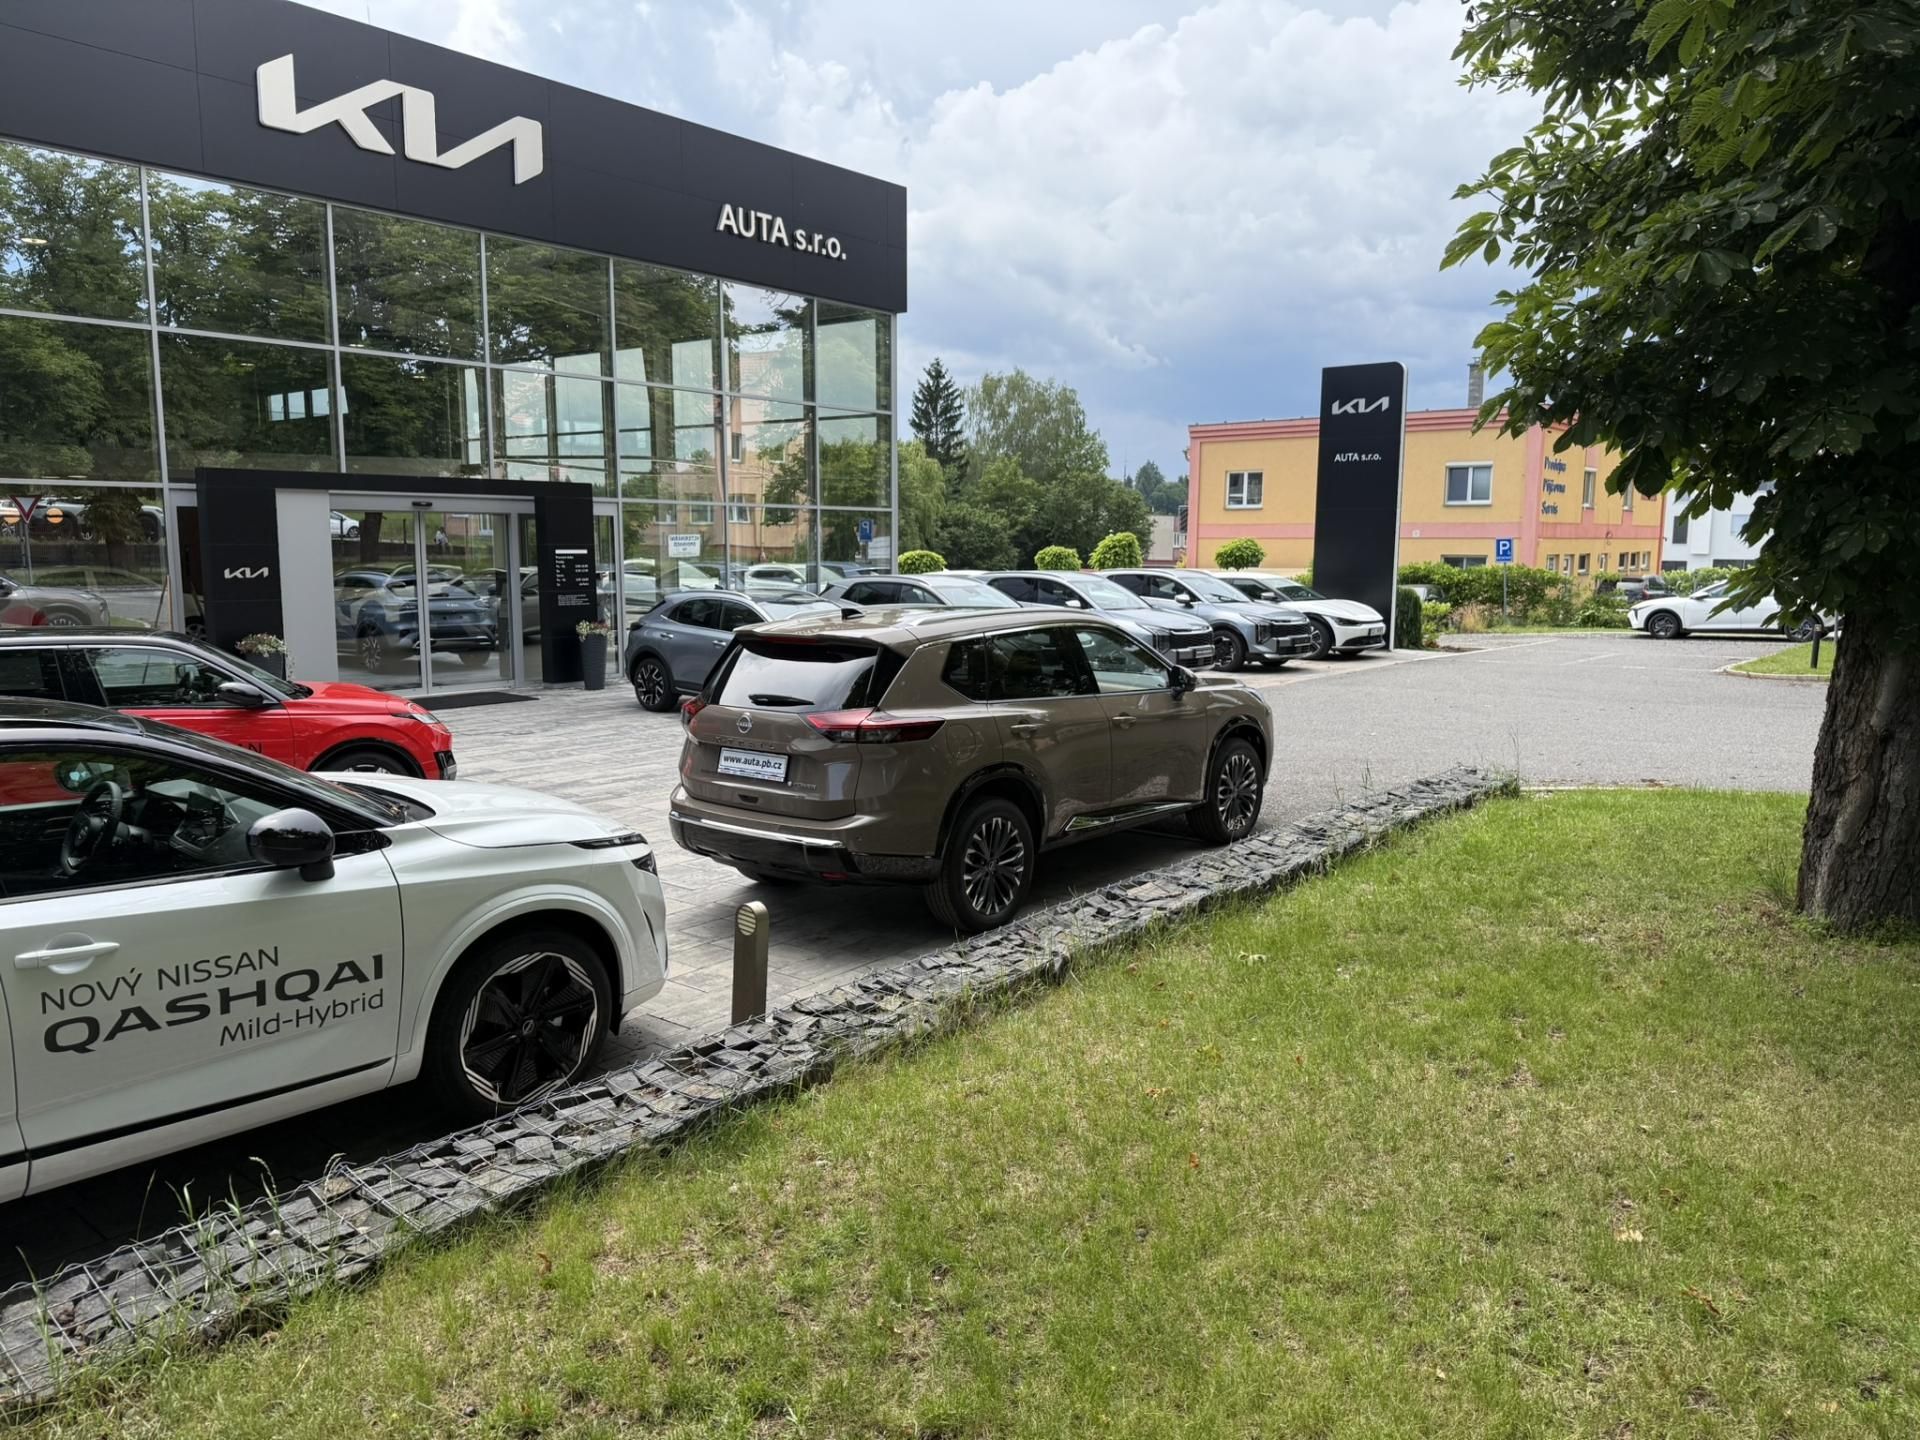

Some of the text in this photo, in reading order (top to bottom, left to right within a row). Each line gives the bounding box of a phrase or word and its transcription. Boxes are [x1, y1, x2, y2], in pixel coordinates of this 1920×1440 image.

[256, 53, 543, 185] KIA
[716, 203, 847, 260] AUTA s.r.o.
[1331, 396, 1390, 415] KIA
[1334, 452, 1382, 462] AUTA s.r.o.
[1499, 541, 1510, 555] P
[223, 566, 269, 579] KIA
[723, 755, 782, 769] www.auta.pb.cz
[41, 946, 279, 1014] NOVÝ NISSAN
[43, 954, 384, 1054] QASHQAI
[220, 988, 384, 1046] Mild-Hybrid
